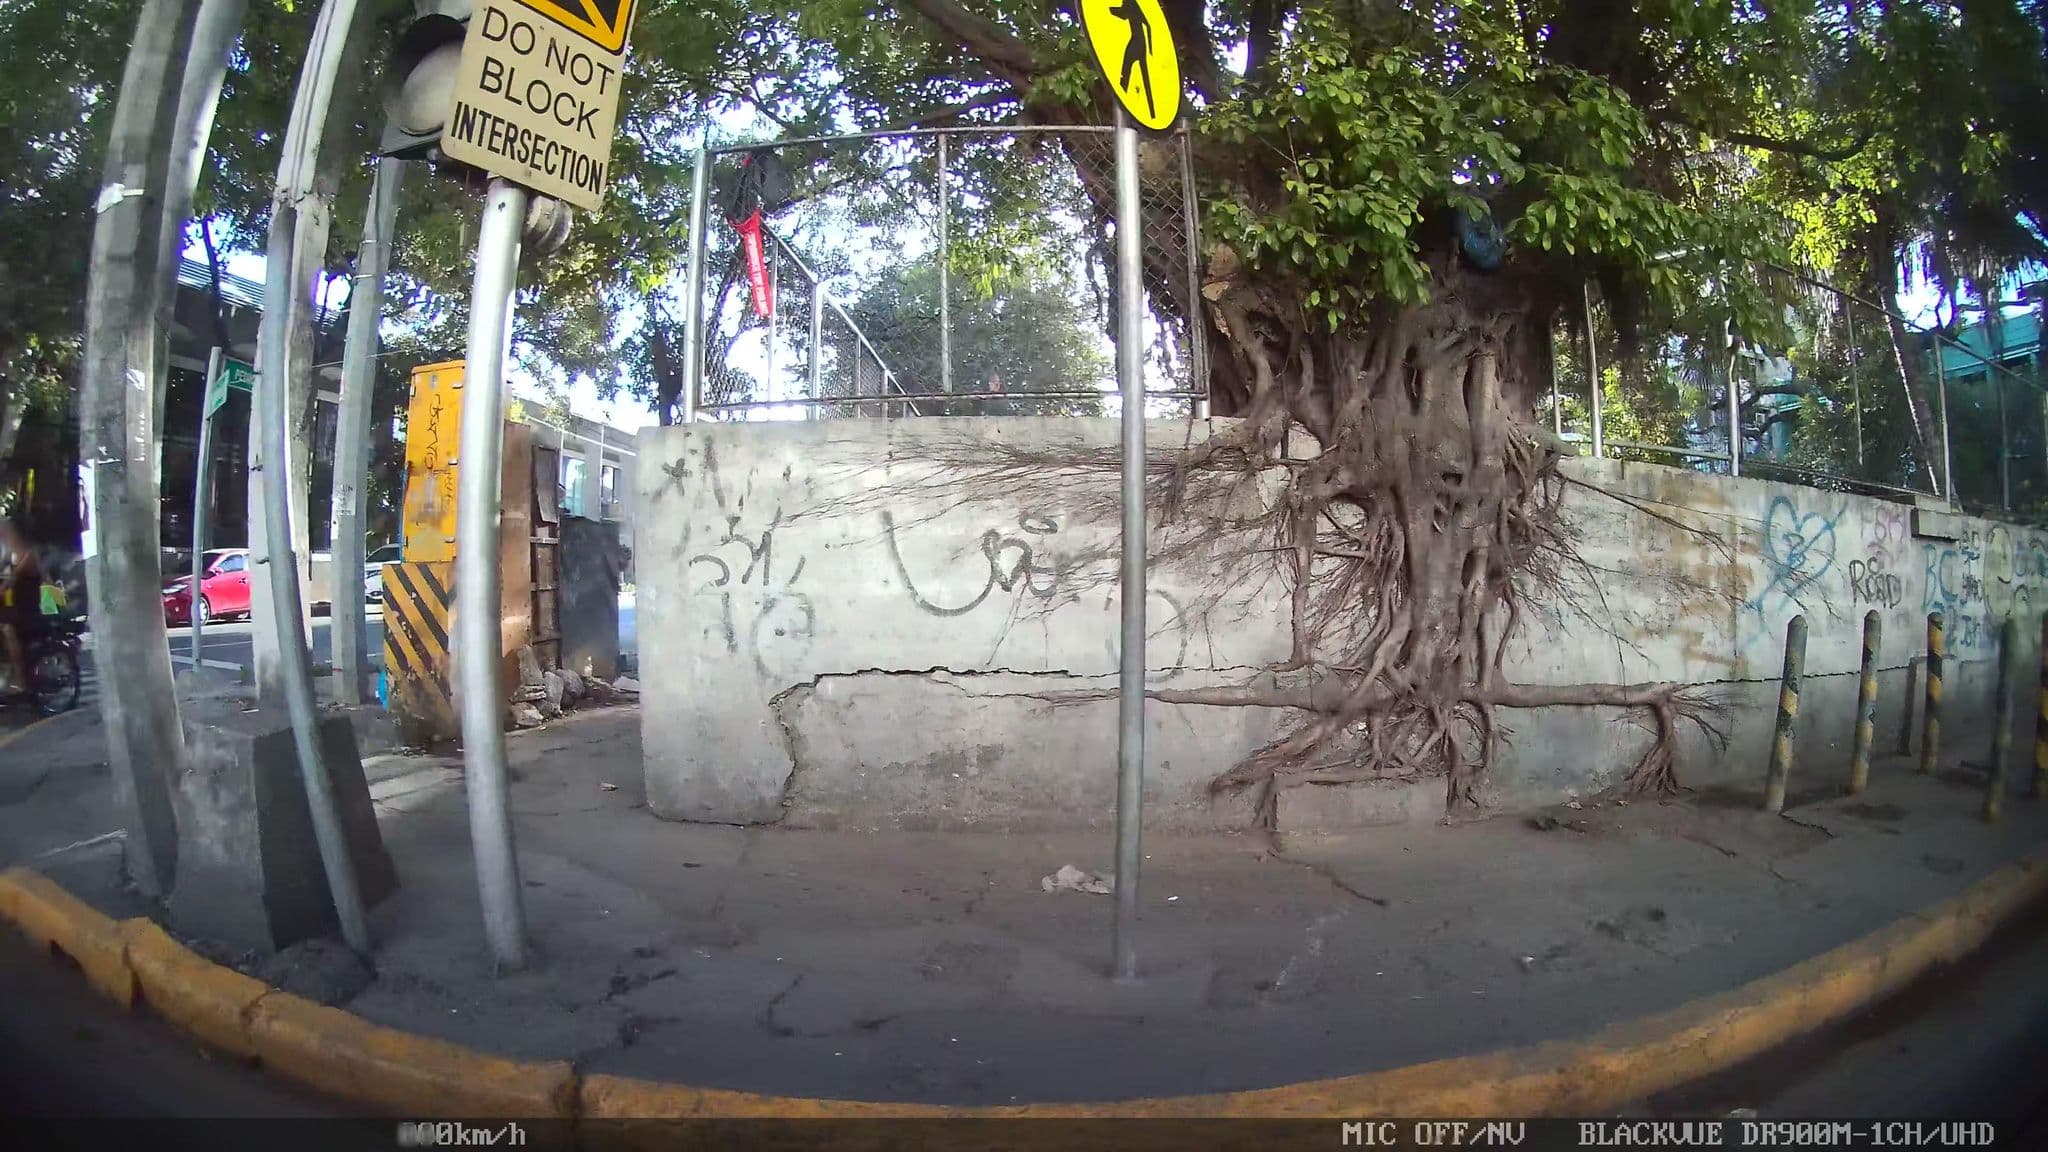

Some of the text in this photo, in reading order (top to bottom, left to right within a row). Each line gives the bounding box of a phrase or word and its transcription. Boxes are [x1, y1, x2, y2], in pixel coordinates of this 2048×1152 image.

[481, 6, 615, 95] DO NOT
[479, 55, 600, 139] BLOCK
[451, 101, 603, 195] INTERSECTION
